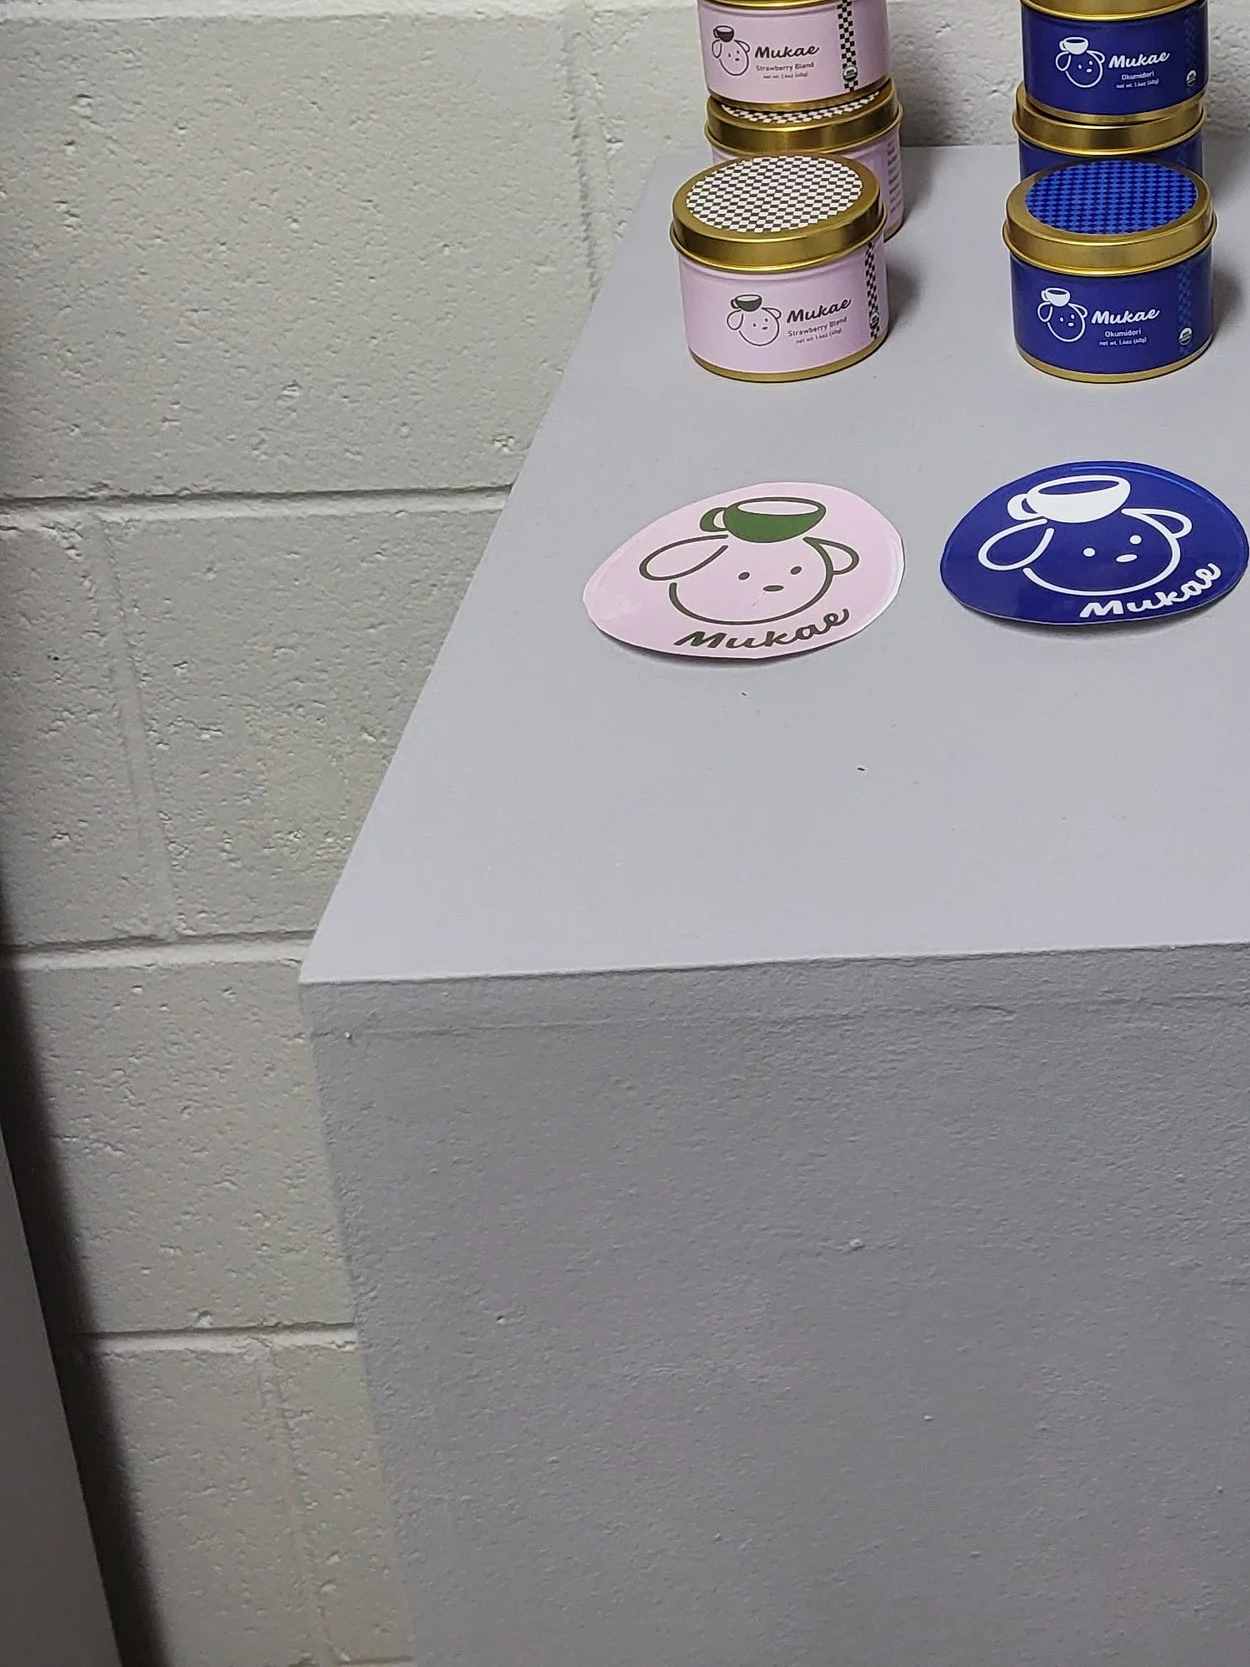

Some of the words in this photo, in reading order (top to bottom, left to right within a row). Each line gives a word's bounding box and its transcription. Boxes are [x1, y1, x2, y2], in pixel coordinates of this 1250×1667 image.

[755, 45, 819, 58] Mukae
[1109, 52, 1170, 68] Mukae
[787, 299, 851, 323] Mukae
[1091, 308, 1160, 324] Mukae
[788, 324, 827, 336] Strawberry
[829, 316, 847, 327] Blend
[1105, 329, 1141, 337] Okumidori
[1079, 562, 1221, 619] Mukae
[674, 608, 850, 650] Mukae
